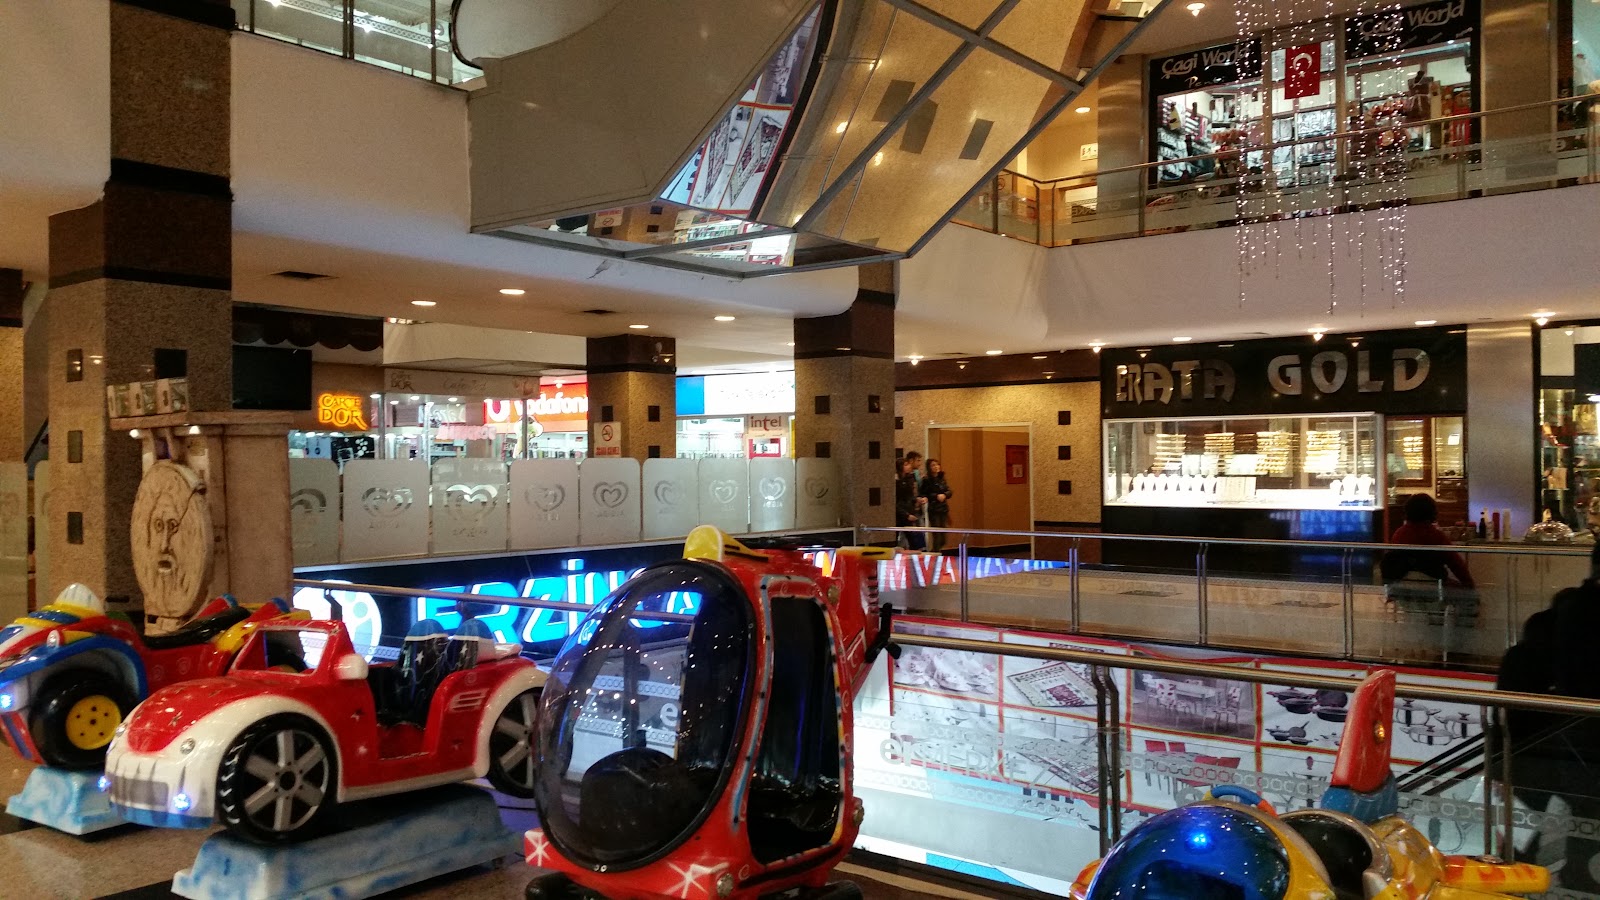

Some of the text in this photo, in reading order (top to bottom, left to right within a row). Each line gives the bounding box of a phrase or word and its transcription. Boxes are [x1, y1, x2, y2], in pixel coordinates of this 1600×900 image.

[1407, 1, 1465, 31] World
[1202, 44, 1251, 71] World
[1116, 348, 1431, 405] ERATA GOLD
[321, 394, 362, 408] CARTE
[751, 415, 782, 431] intel
